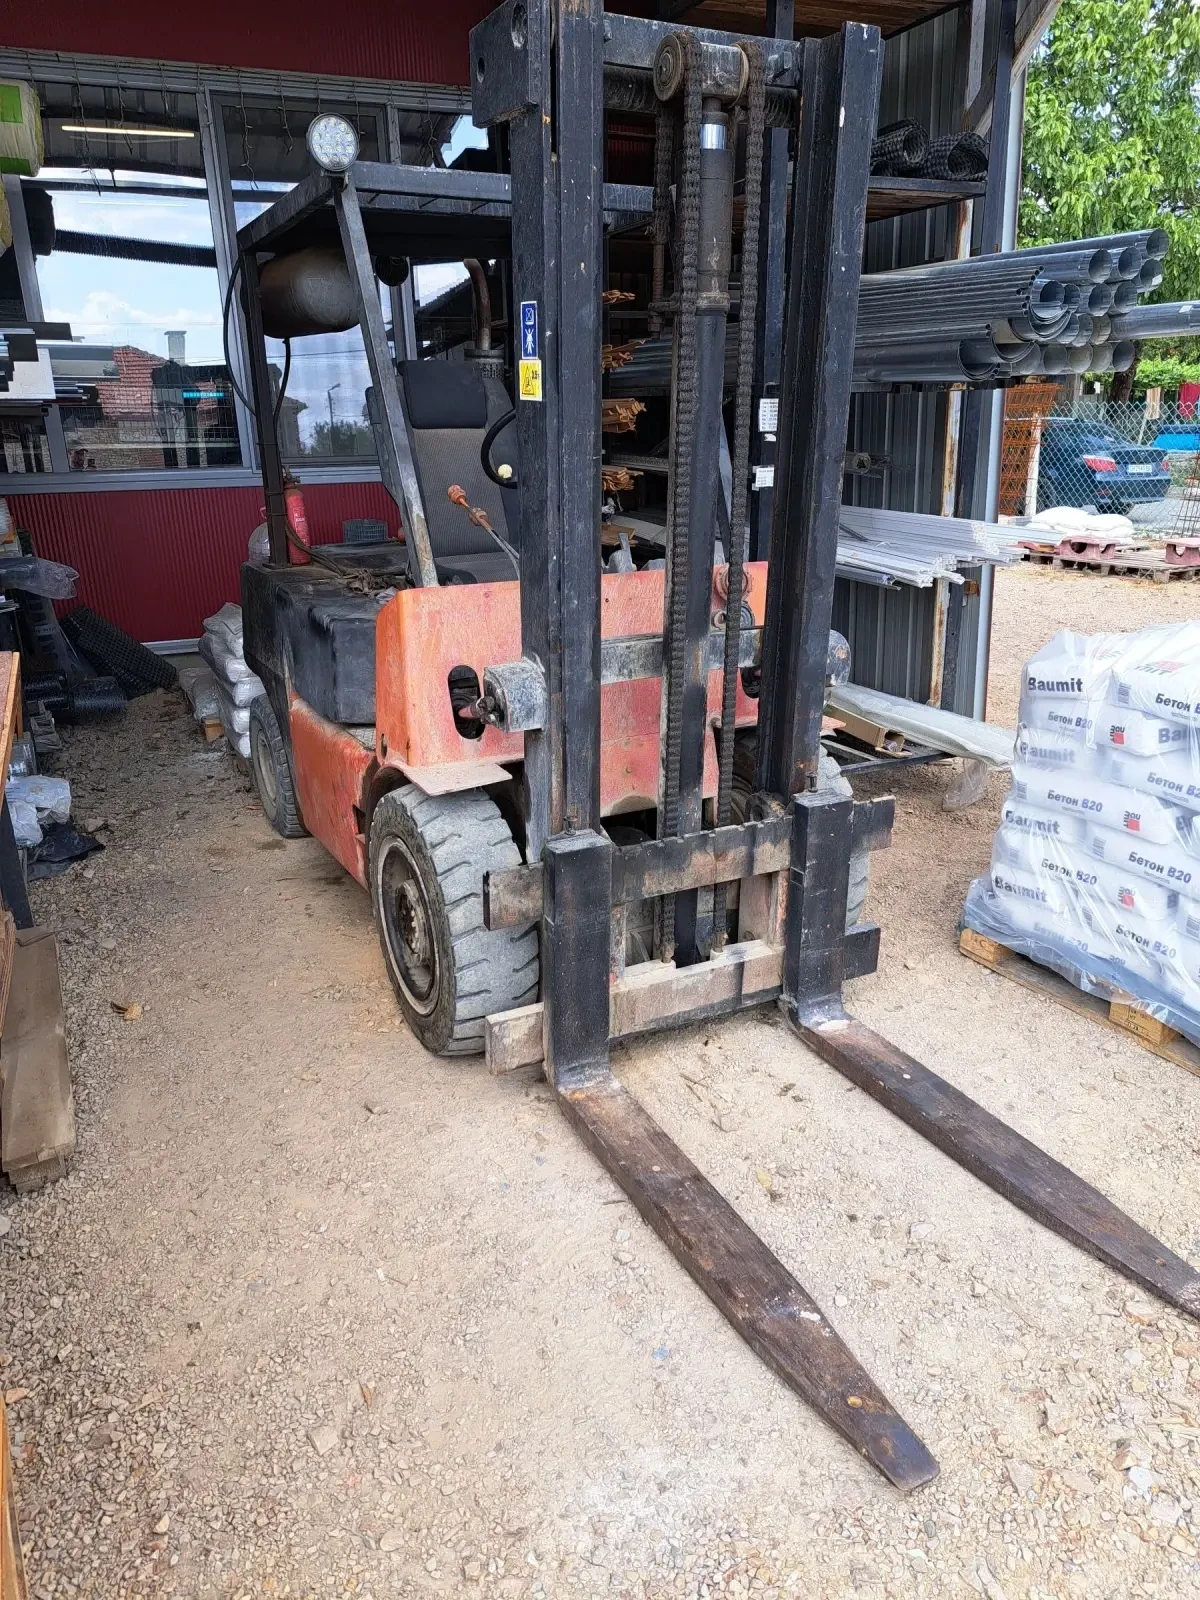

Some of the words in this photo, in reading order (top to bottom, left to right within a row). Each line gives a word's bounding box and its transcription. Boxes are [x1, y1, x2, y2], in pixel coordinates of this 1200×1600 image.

[1028, 677, 1083, 692] Baumit
[1155, 692, 1191, 712] Бетон
[1048, 711, 1073, 725] Бетон
[1021, 742, 1075, 762] Baumit
[1147, 772, 1183, 792] Бетон
[1047, 789, 1079, 806] Бетон
[1081, 798, 1103, 812] B20
[1005, 810, 1060, 834] Baumit
[1041, 858, 1073, 877] Бетон
[1076, 870, 1097, 885] B20
[1128, 851, 1164, 873] Бетон
[1167, 866, 1192, 883] B20
[995, 875, 1047, 902] Baumit
[1115, 923, 1150, 947] Бетон
